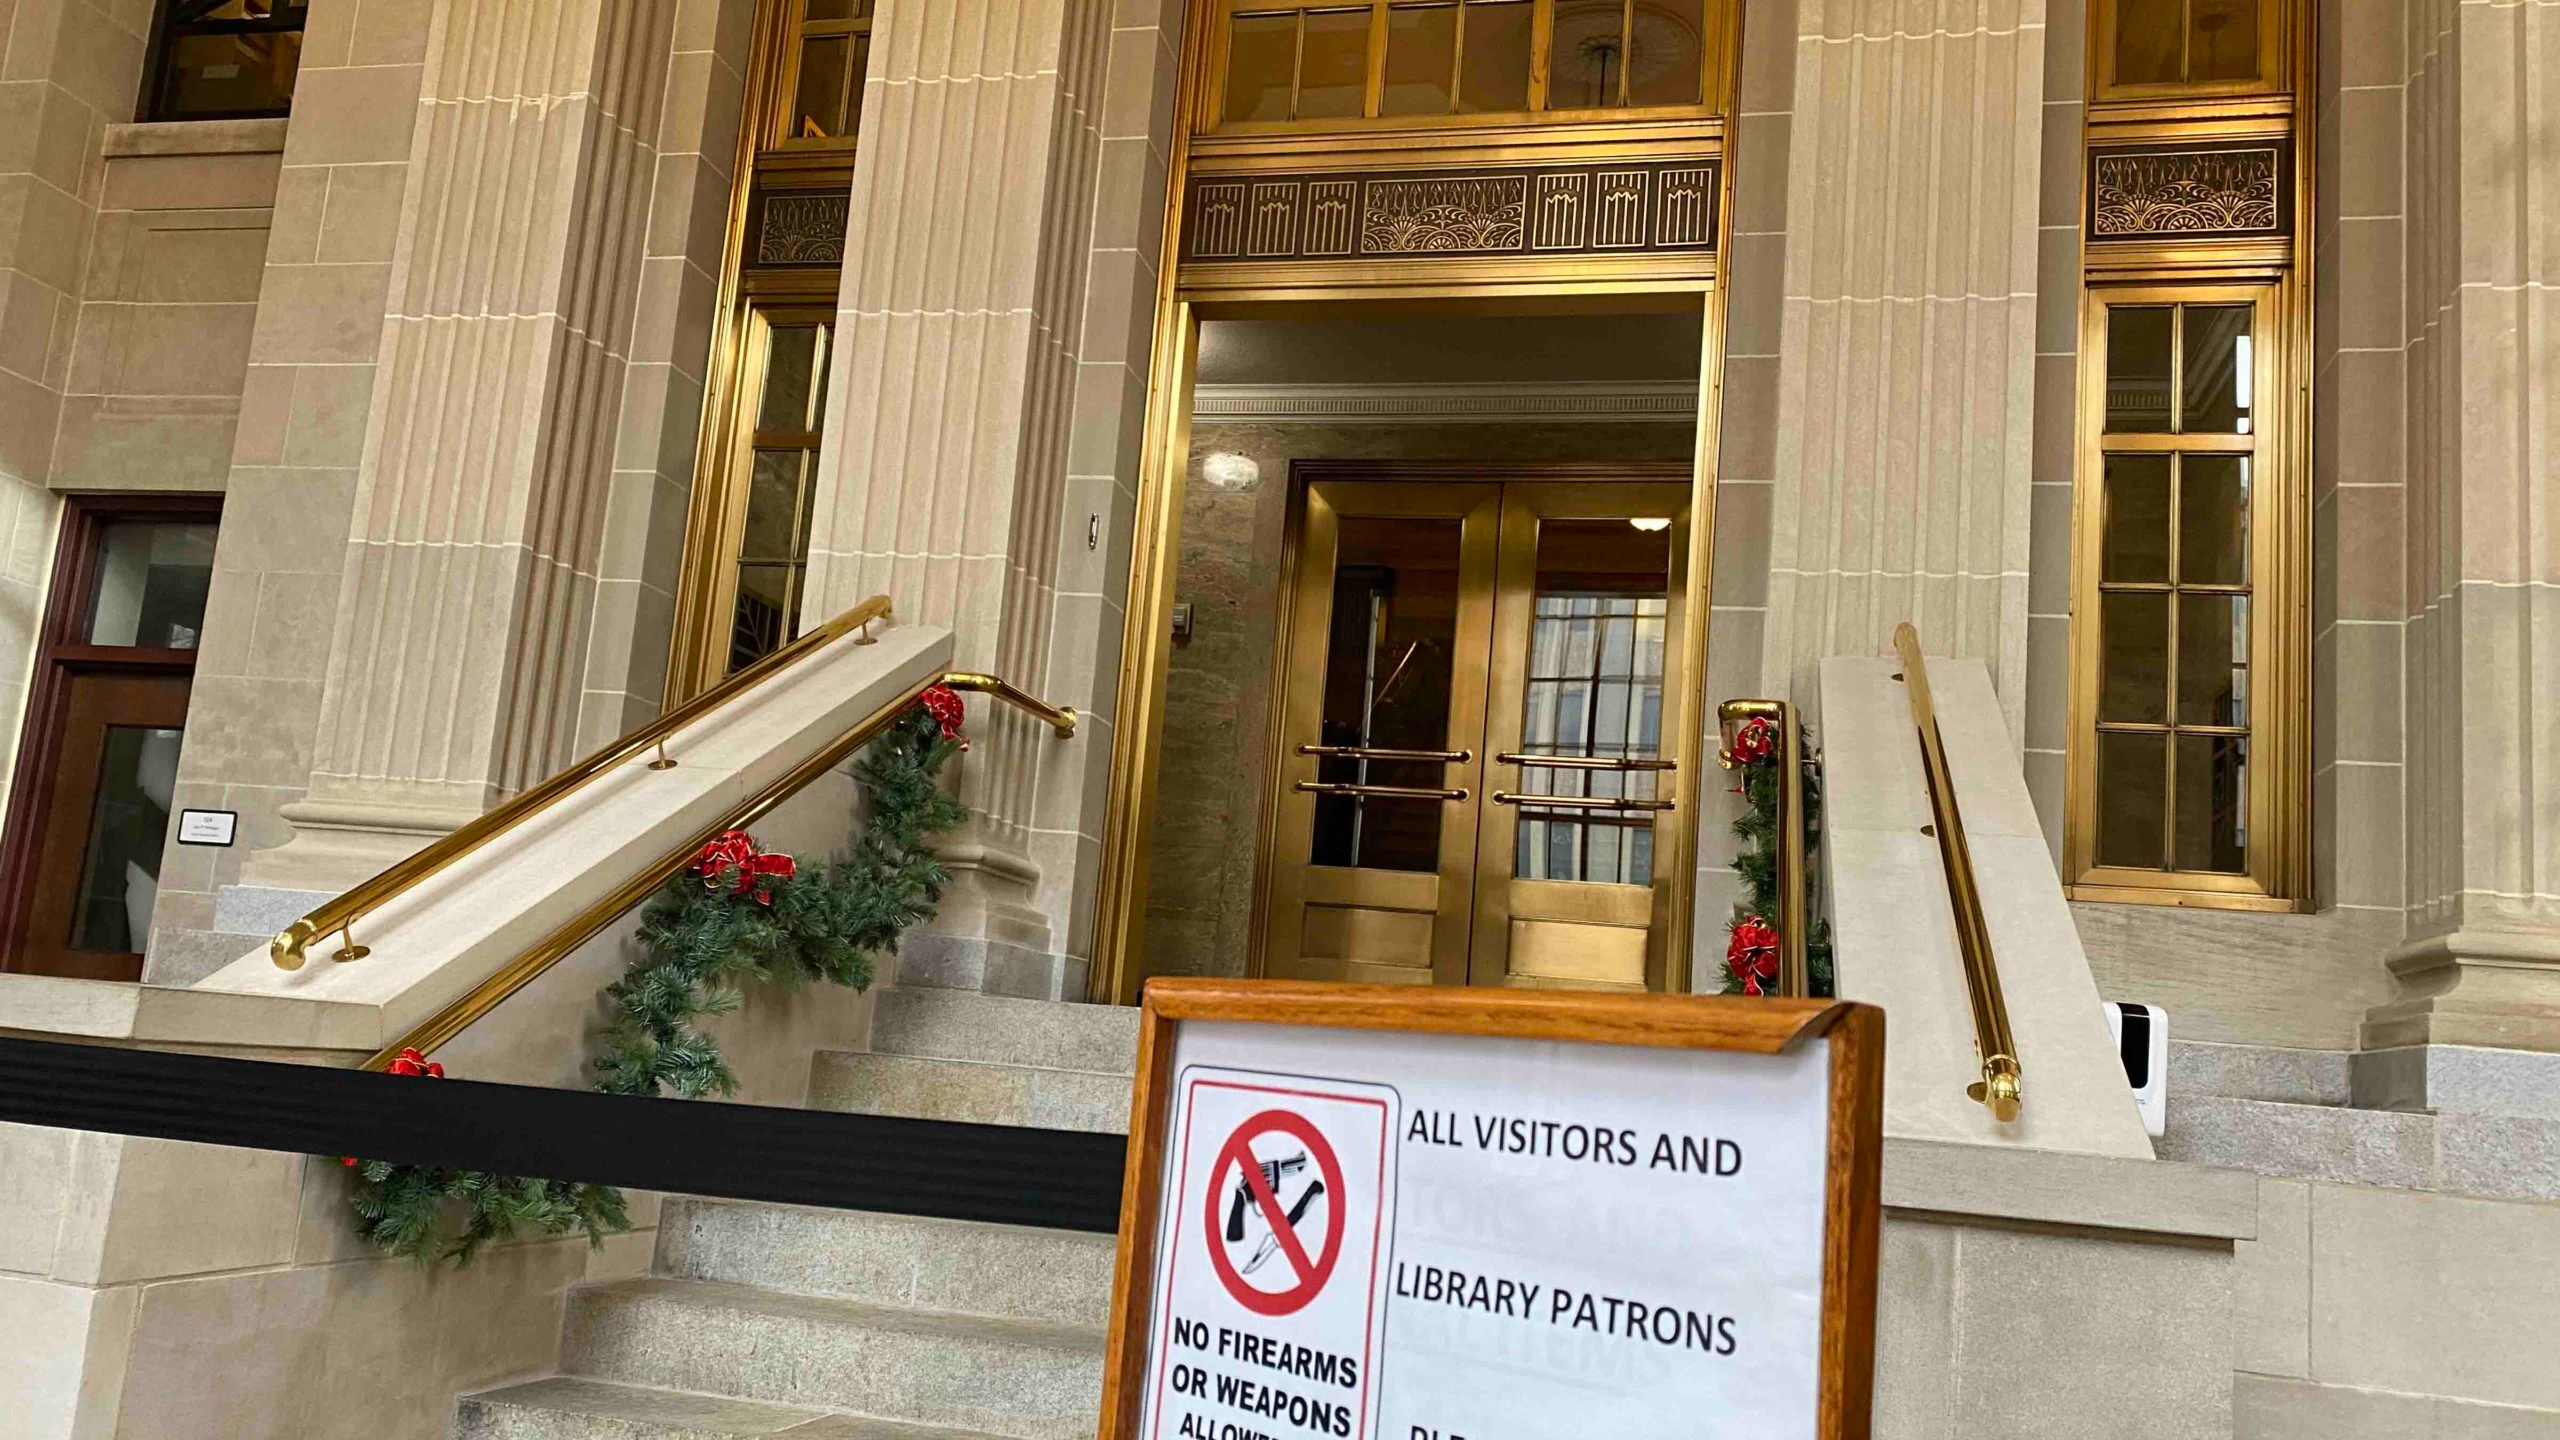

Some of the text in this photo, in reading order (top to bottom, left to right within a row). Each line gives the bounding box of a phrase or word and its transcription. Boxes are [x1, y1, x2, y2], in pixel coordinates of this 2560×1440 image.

[1407, 1109, 1743, 1177] ALL VISITORS AND
[1396, 1262, 1540, 1319] LIBRARY
[1550, 1288, 1737, 1356] PATRONS
[1173, 1316, 1210, 1351] NO
[1217, 1327, 1358, 1388] FIREARMS
[1172, 1363, 1351, 1438] OR WEAPONS
[1179, 1412, 1280, 1440] ALLOW
